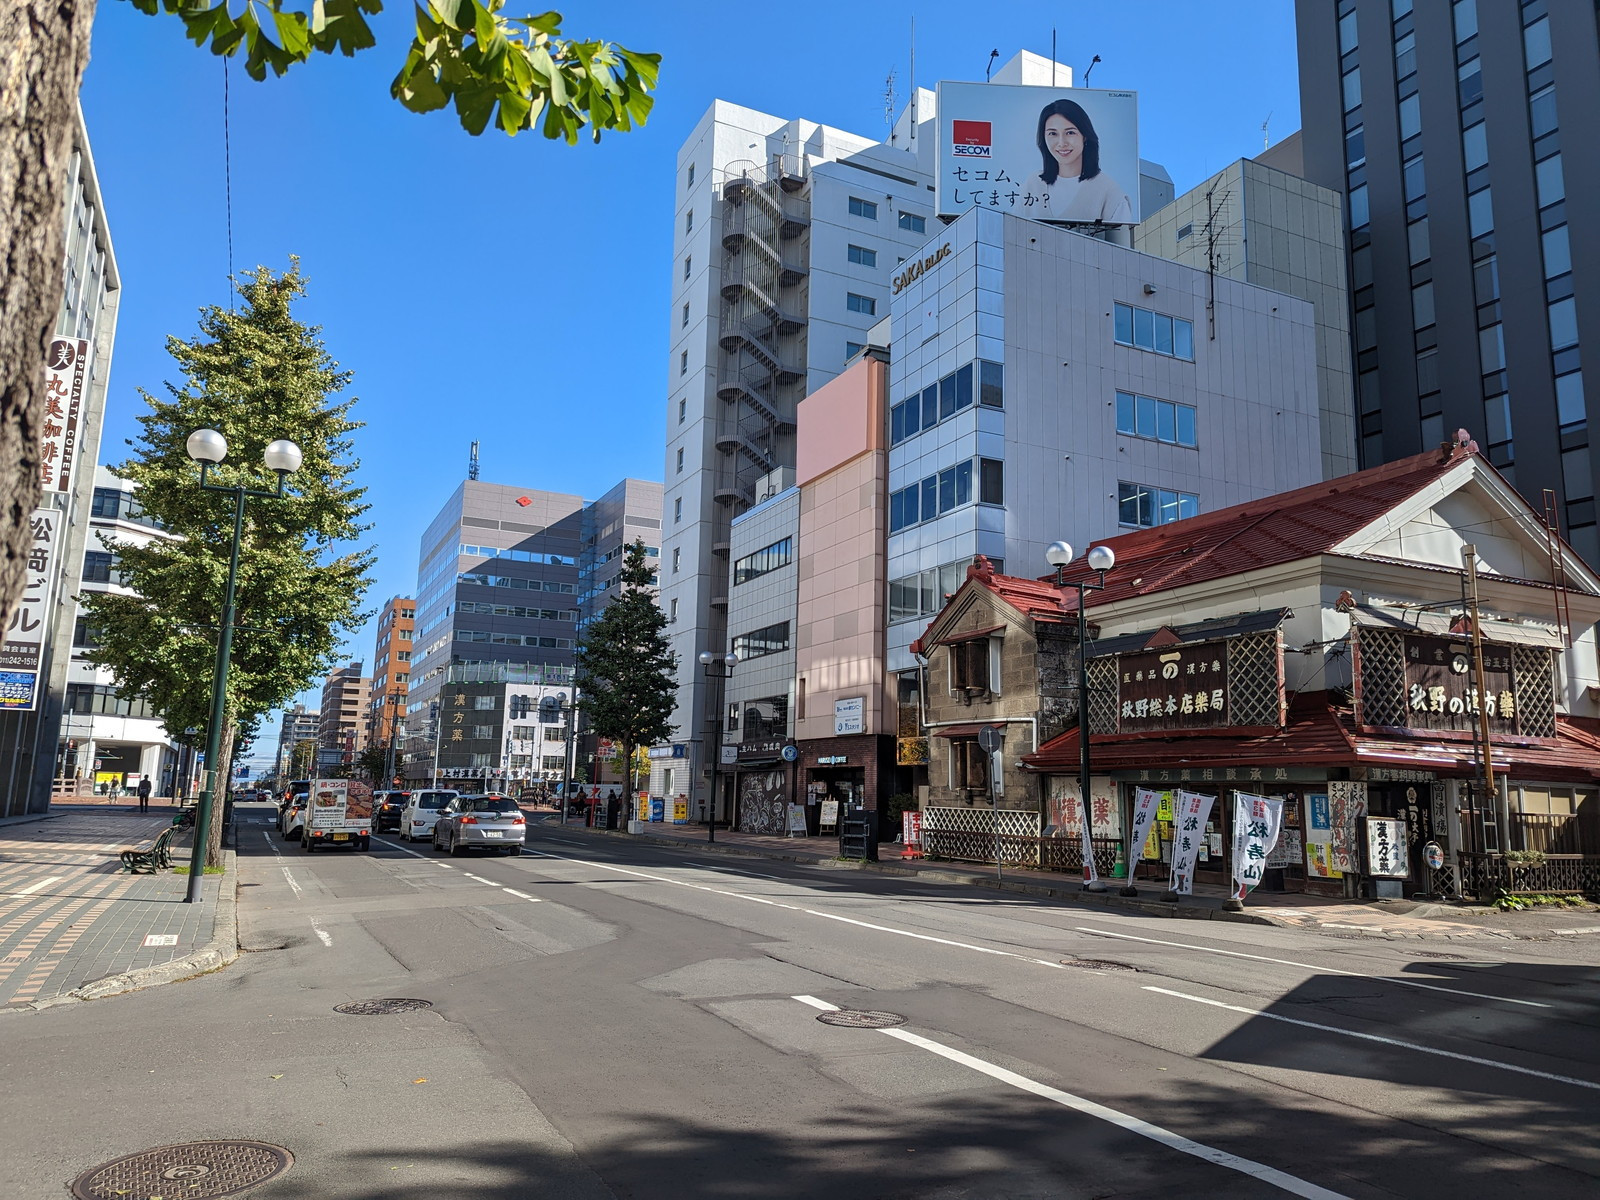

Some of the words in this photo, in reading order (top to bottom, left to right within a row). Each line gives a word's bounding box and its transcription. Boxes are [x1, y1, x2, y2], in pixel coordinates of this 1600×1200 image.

[955, 145, 990, 155] SECOM
[952, 166, 1020, 187] セコム、
[954, 188, 1051, 209] してますか?
[892, 259, 925, 295] SAKA
[69, 354, 85, 420] SPECIALTY
[61, 429, 74, 476] COFFEE
[1187, 660, 1221, 675] 漢方薬
[451, 693, 466, 742] 漢方薬
[1121, 689, 1224, 720] 秋野総本店薬局
[1140, 768, 1288, 781] 漢方薬相談承処
